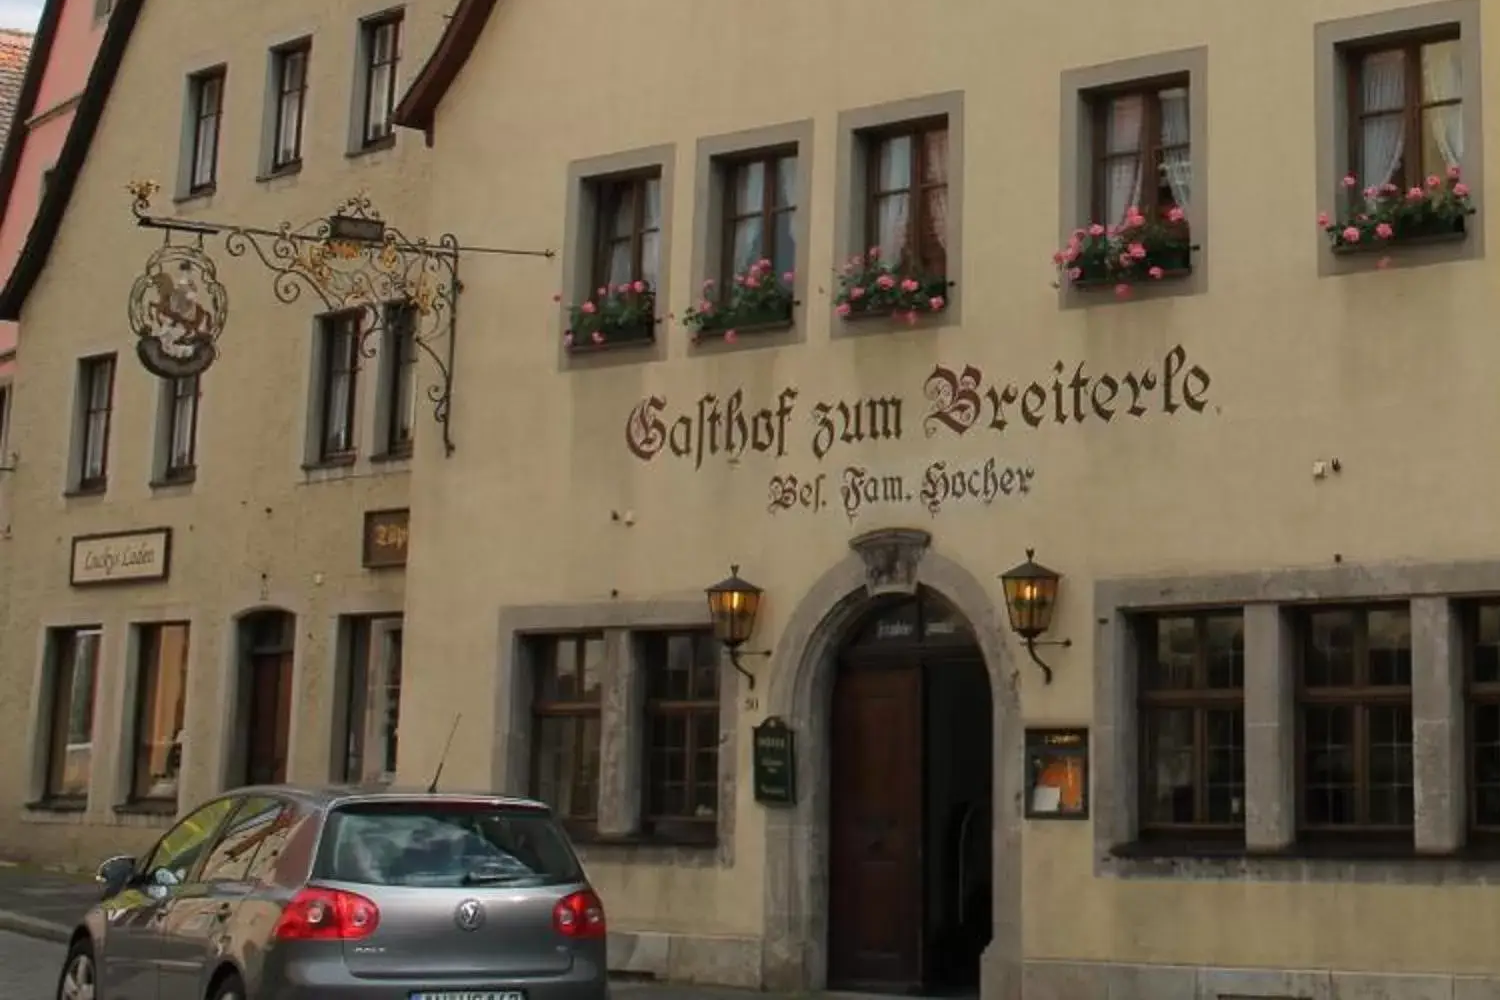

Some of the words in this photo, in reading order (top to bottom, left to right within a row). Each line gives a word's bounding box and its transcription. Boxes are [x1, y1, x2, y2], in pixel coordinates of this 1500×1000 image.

[626, 387, 798, 472] Gasthof
[812, 395, 904, 461] zum
[923, 344, 1211, 438] Breiterle
[841, 465, 912, 526] Fam.
[920, 457, 1035, 519] Hocher
